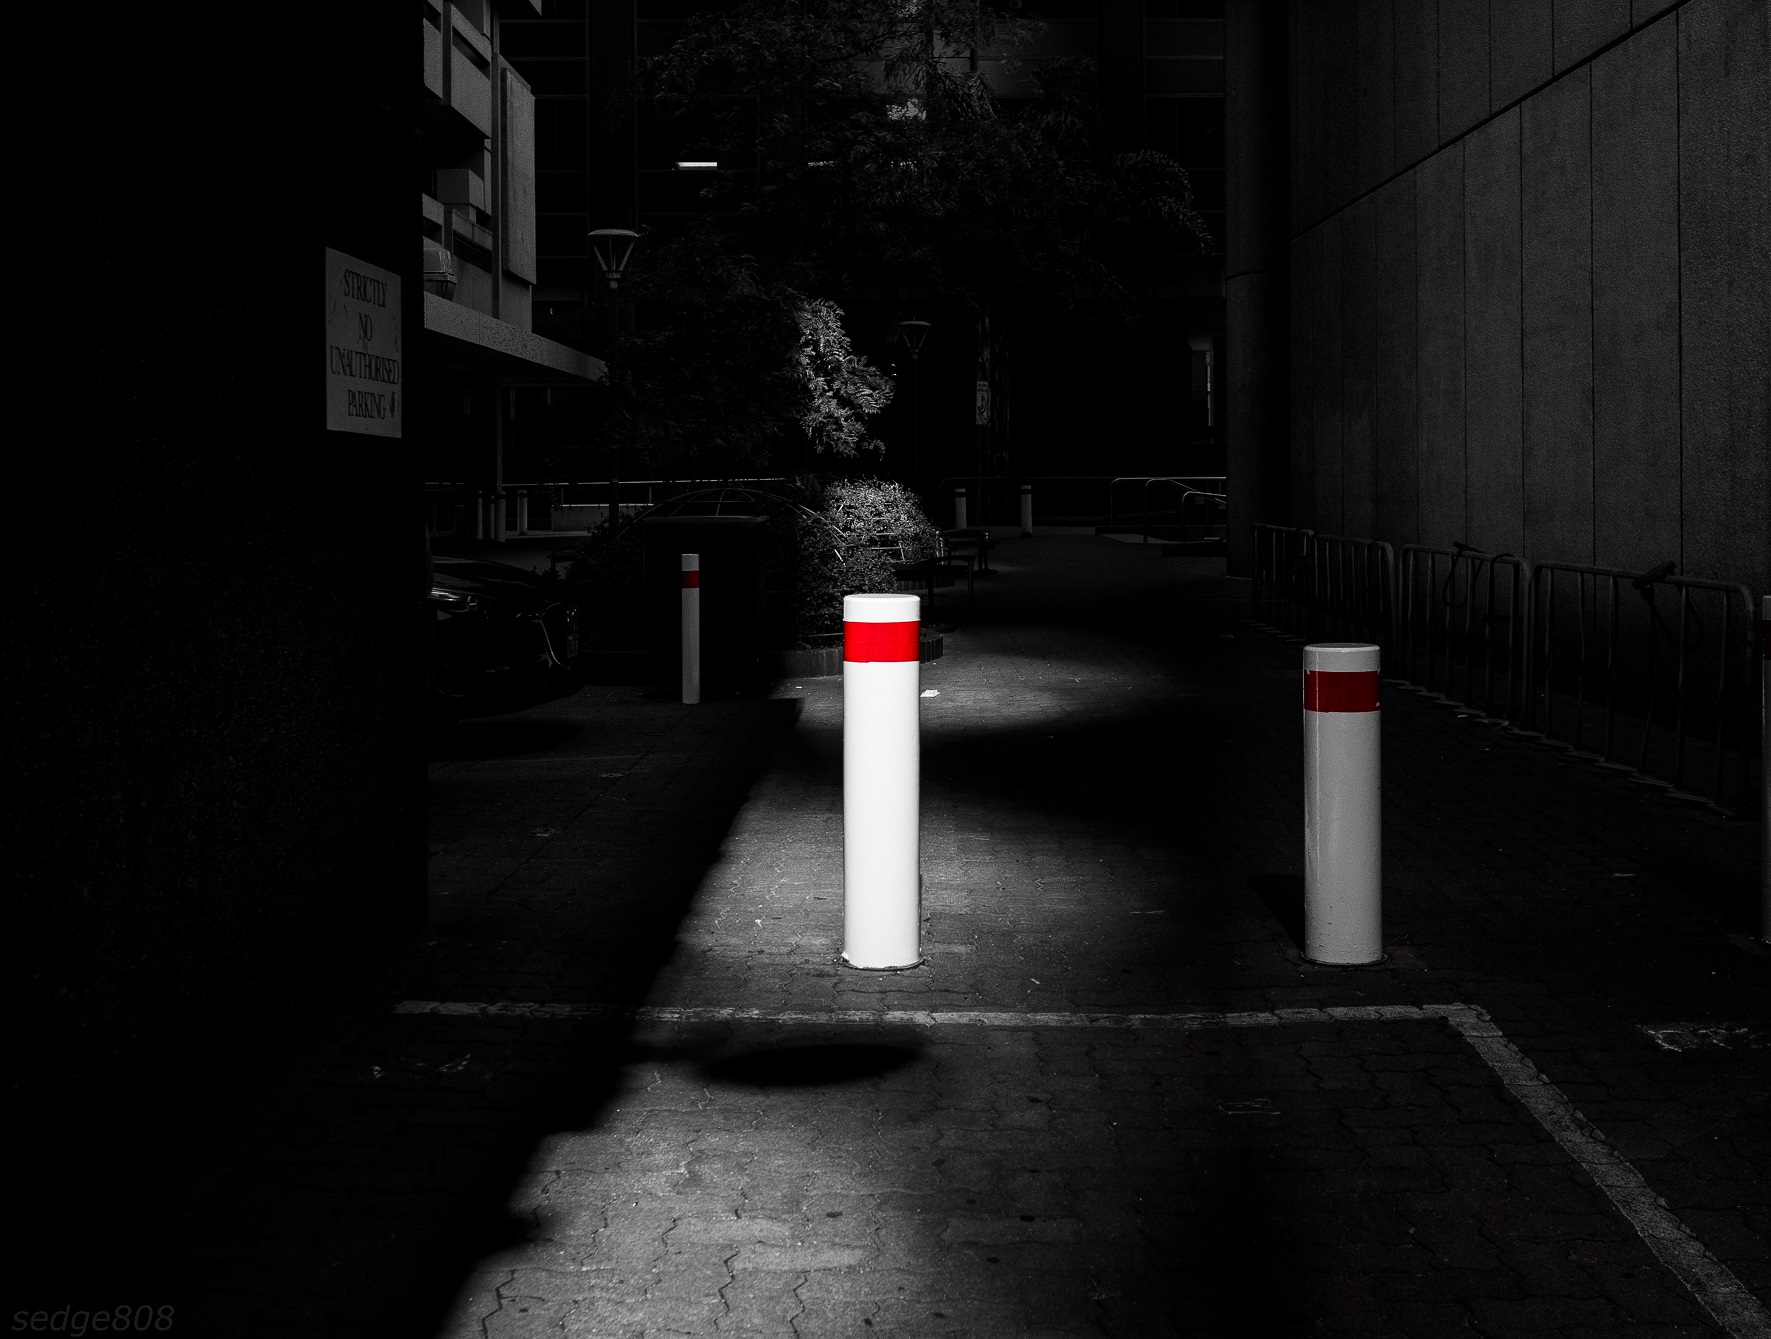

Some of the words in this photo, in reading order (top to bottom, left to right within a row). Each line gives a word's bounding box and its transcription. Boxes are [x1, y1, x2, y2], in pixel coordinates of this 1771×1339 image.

[344, 269, 387, 308] STRICTLY
[358, 312, 373, 342] NO
[330, 345, 400, 385] UNAUTHORISED
[348, 388, 386, 421] PARKING
